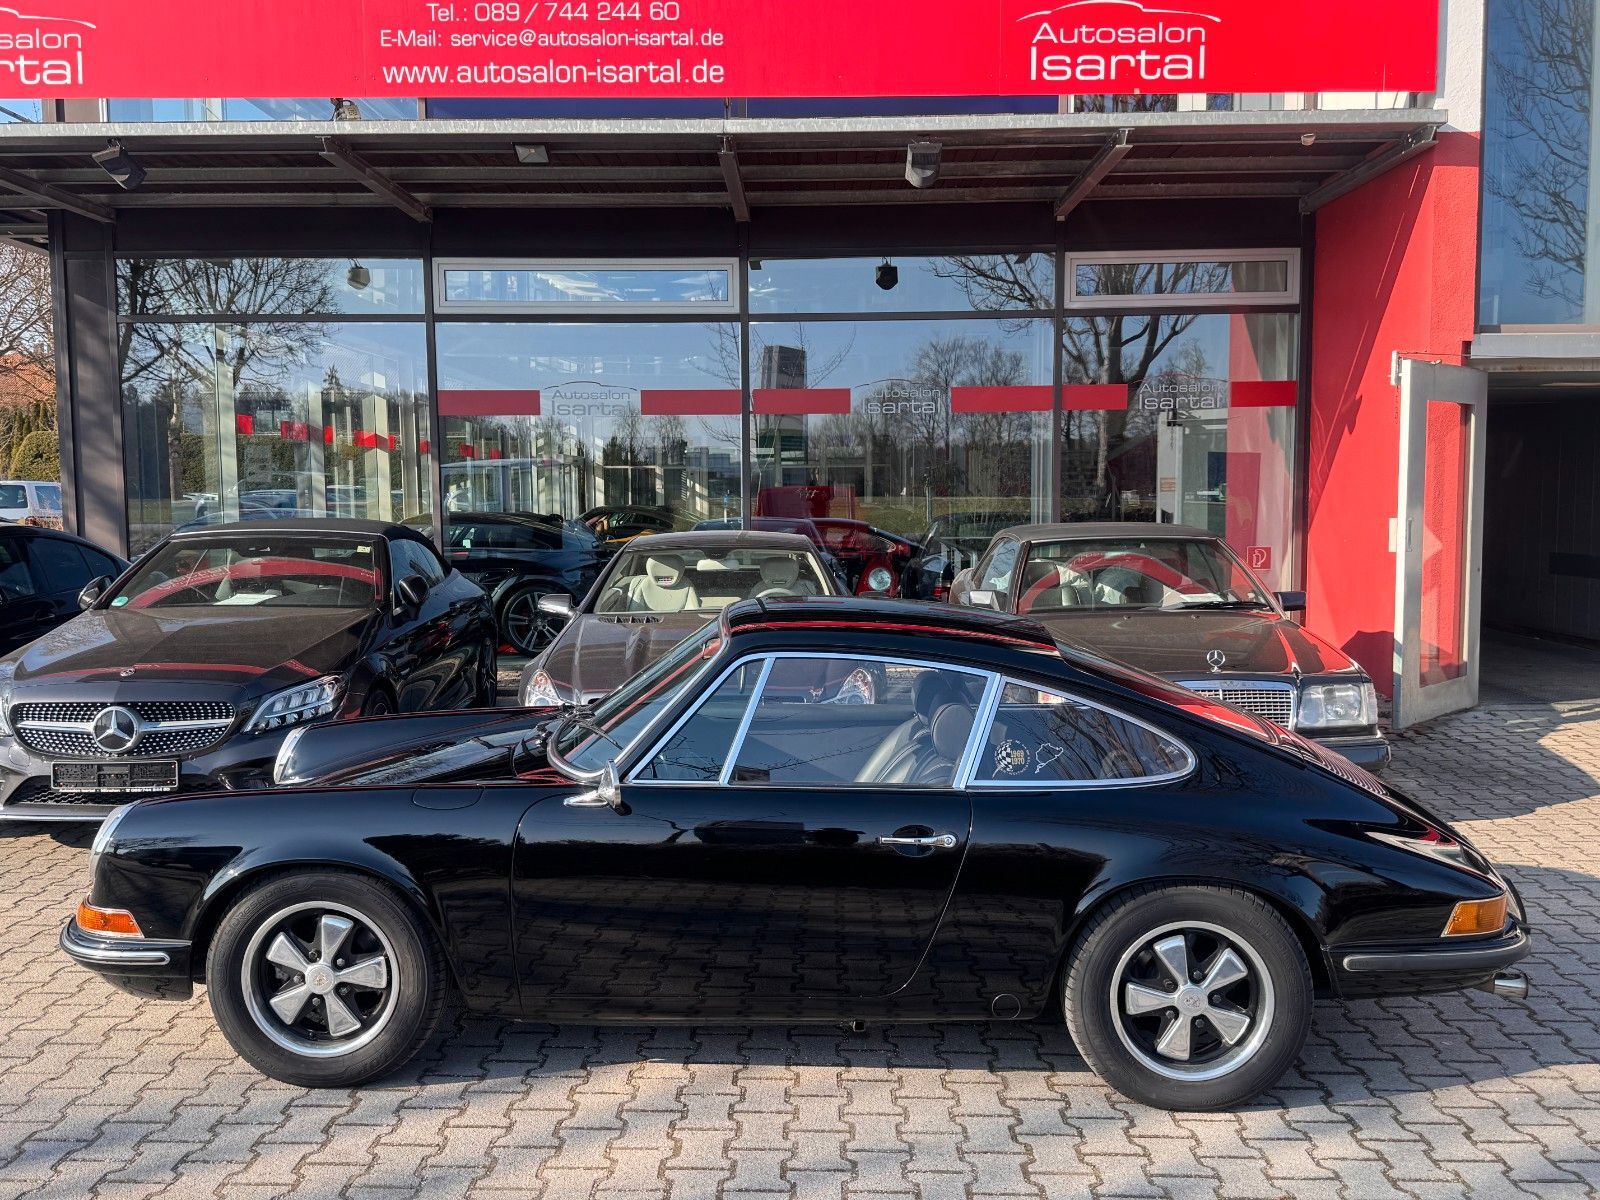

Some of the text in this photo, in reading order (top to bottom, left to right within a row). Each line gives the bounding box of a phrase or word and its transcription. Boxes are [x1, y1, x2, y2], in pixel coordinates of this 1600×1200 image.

[426, 3, 468, 22] Tel.:
[474, 2, 521, 22] 089
[545, 1, 589, 21] 744
[597, 1, 642, 21] 244
[650, 1, 680, 21] 60
[380, 28, 724, 47] E-Mail: service@autosalon-isartal.de
[1031, 22, 1206, 44] Autosalon
[382, 58, 725, 84] www.autosalon-isartal.de
[1030, 45, 1206, 81] Isartal
[552, 389, 631, 400] Autosalon
[865, 387, 941, 398] utosalon
[551, 400, 631, 416] Isartal
[862, 397, 941, 414] Isartal
